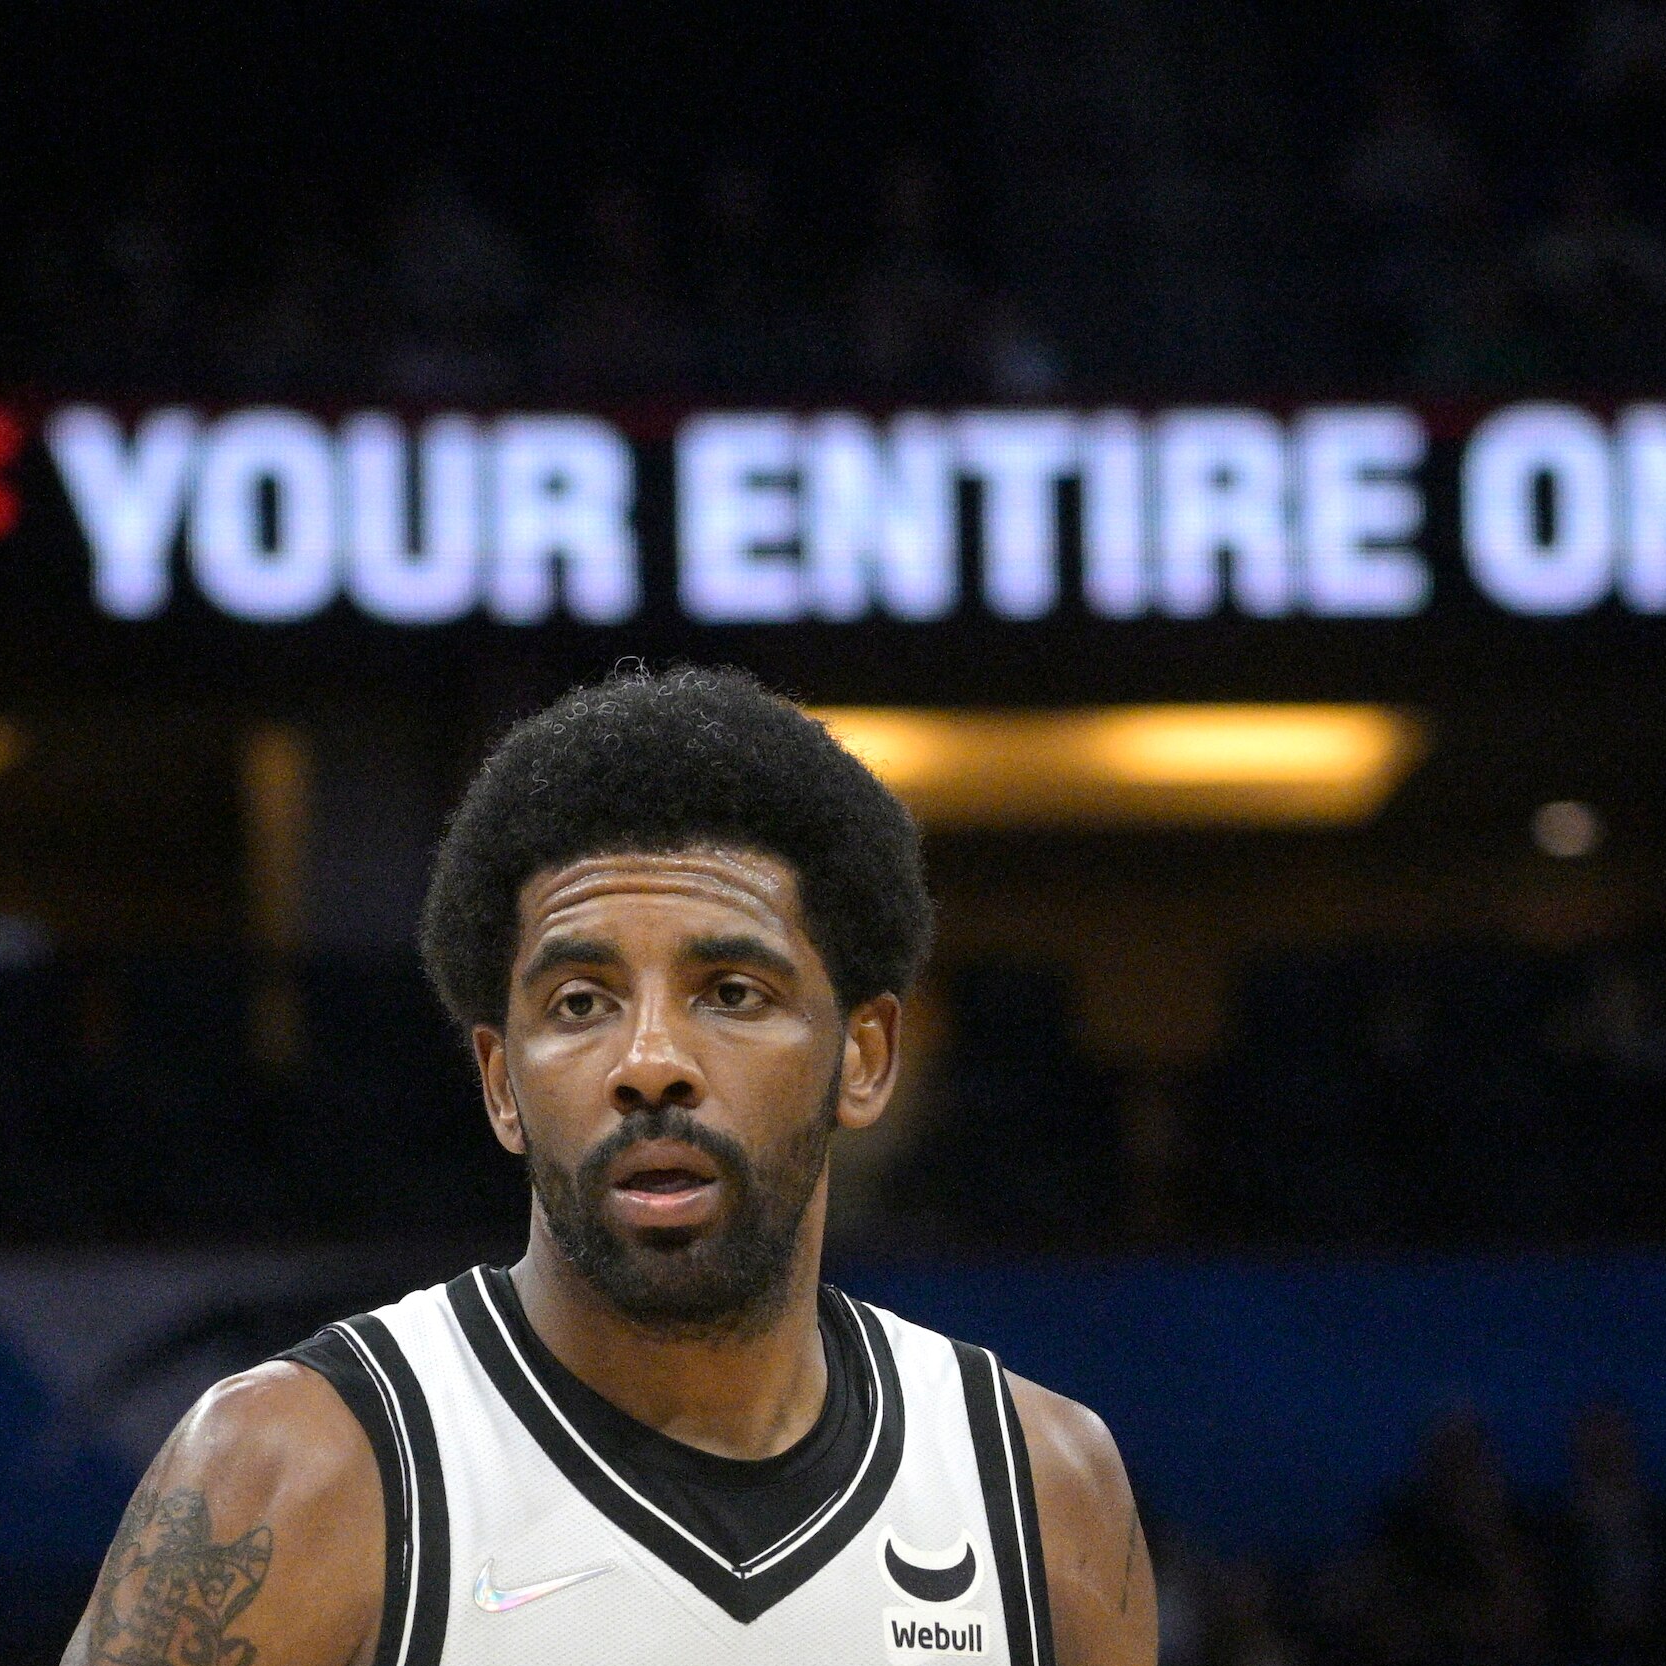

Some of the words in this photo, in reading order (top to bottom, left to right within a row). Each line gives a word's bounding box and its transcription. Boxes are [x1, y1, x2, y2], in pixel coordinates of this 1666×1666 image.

[50, 407, 638, 622] YOUR
[675, 406, 1427, 621] ENTIRE
[891, 1620, 982, 1652] Webull
